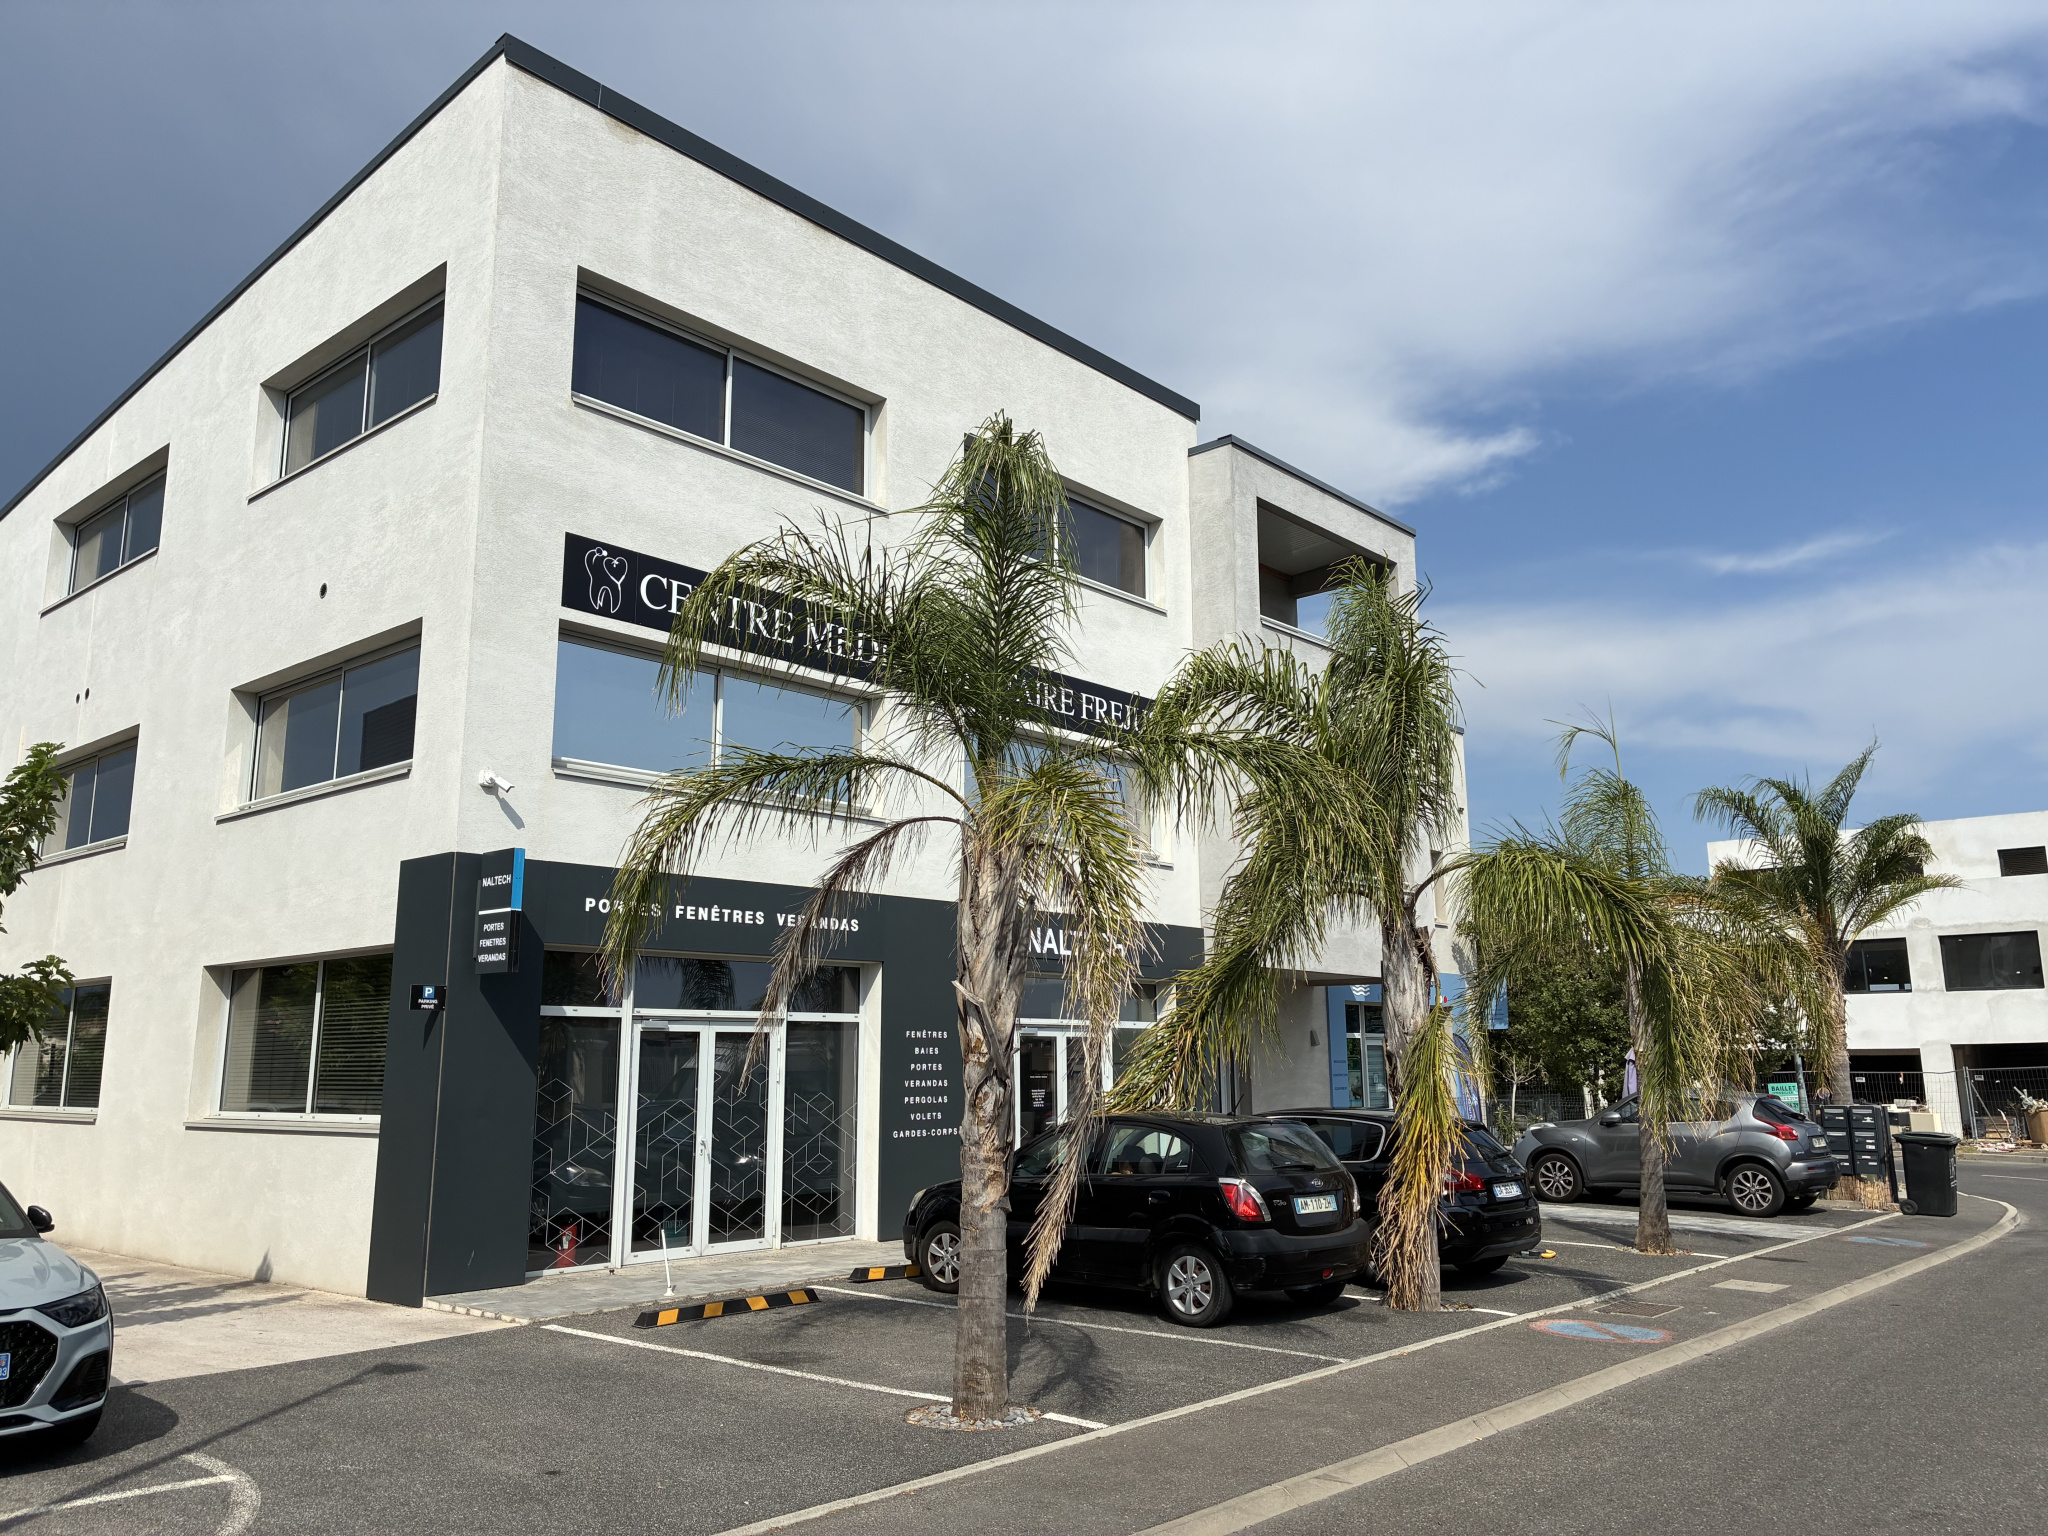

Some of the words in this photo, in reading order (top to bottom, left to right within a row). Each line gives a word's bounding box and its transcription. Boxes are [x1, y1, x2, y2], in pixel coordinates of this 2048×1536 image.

[482, 873, 511, 887] NALTECH
[675, 904, 765, 925] FENÊTRES
[483, 922, 504, 932] PORTES
[479, 937, 506, 948] FENETRES
[477, 952, 506, 963] VERANDAS
[425, 987, 433, 998] P
[906, 1029, 948, 1039] FENÊTRES
[914, 1047, 939, 1055] BAIES
[910, 1063, 943, 1071] PORTES
[904, 1079, 948, 1088] VERANDAS
[904, 1095, 948, 1104] PERGOLAS
[910, 1112, 942, 1121] VOLETS
[892, 1127, 958, 1139] GARDES-CORPS
[1300, 1197, 1333, 1211] AM-110-ZH
